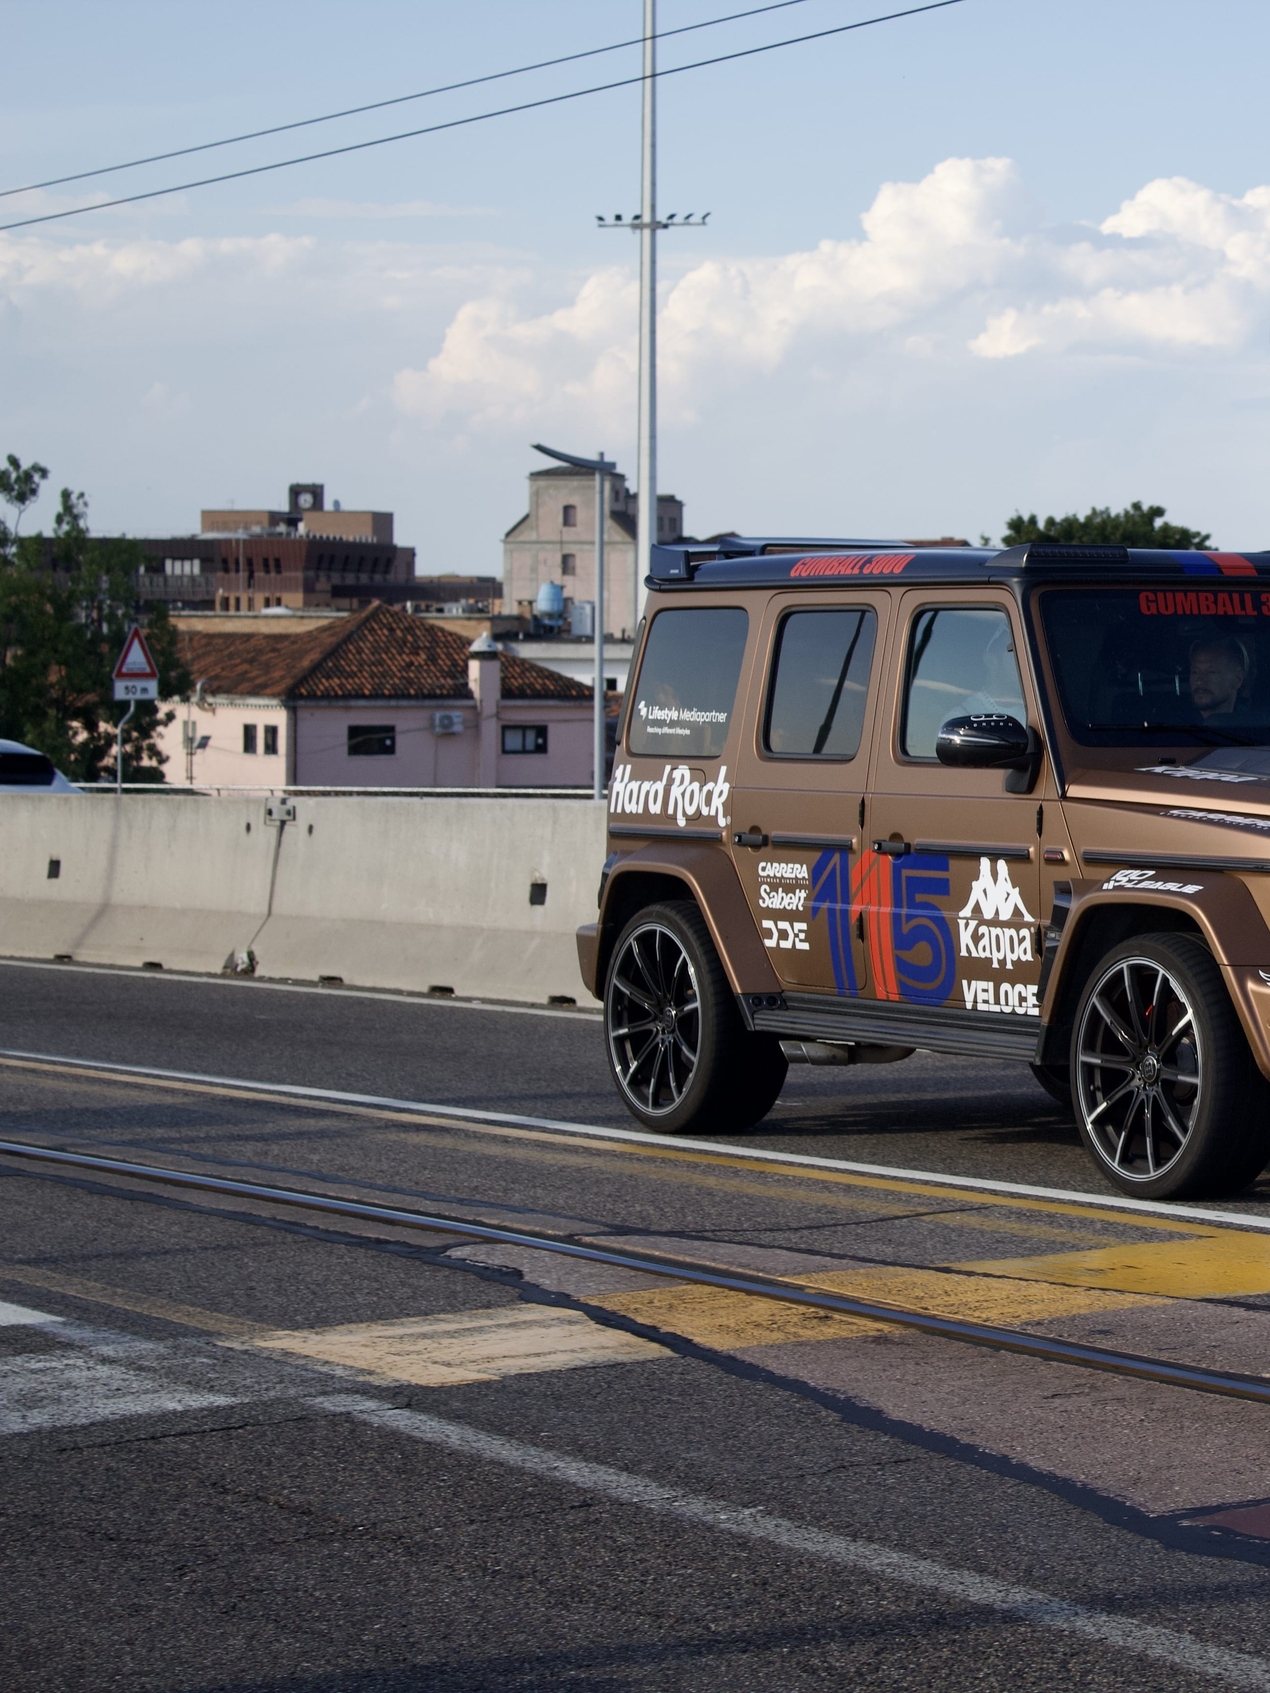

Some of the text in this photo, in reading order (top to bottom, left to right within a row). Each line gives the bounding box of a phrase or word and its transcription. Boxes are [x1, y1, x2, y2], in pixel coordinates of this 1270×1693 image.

[789, 554, 917, 578] GUMBALL 3000
[1138, 591, 1258, 616] GUMBALL
[648, 705, 727, 725] Lifestyle Mediapartner
[609, 764, 731, 828] Hard Rock
[757, 861, 809, 879] CARRERA
[758, 884, 807, 911] Sabelt
[811, 848, 957, 1007] 115
[957, 918, 1035, 970] Kappa
[961, 979, 1041, 1016] VELOCE
